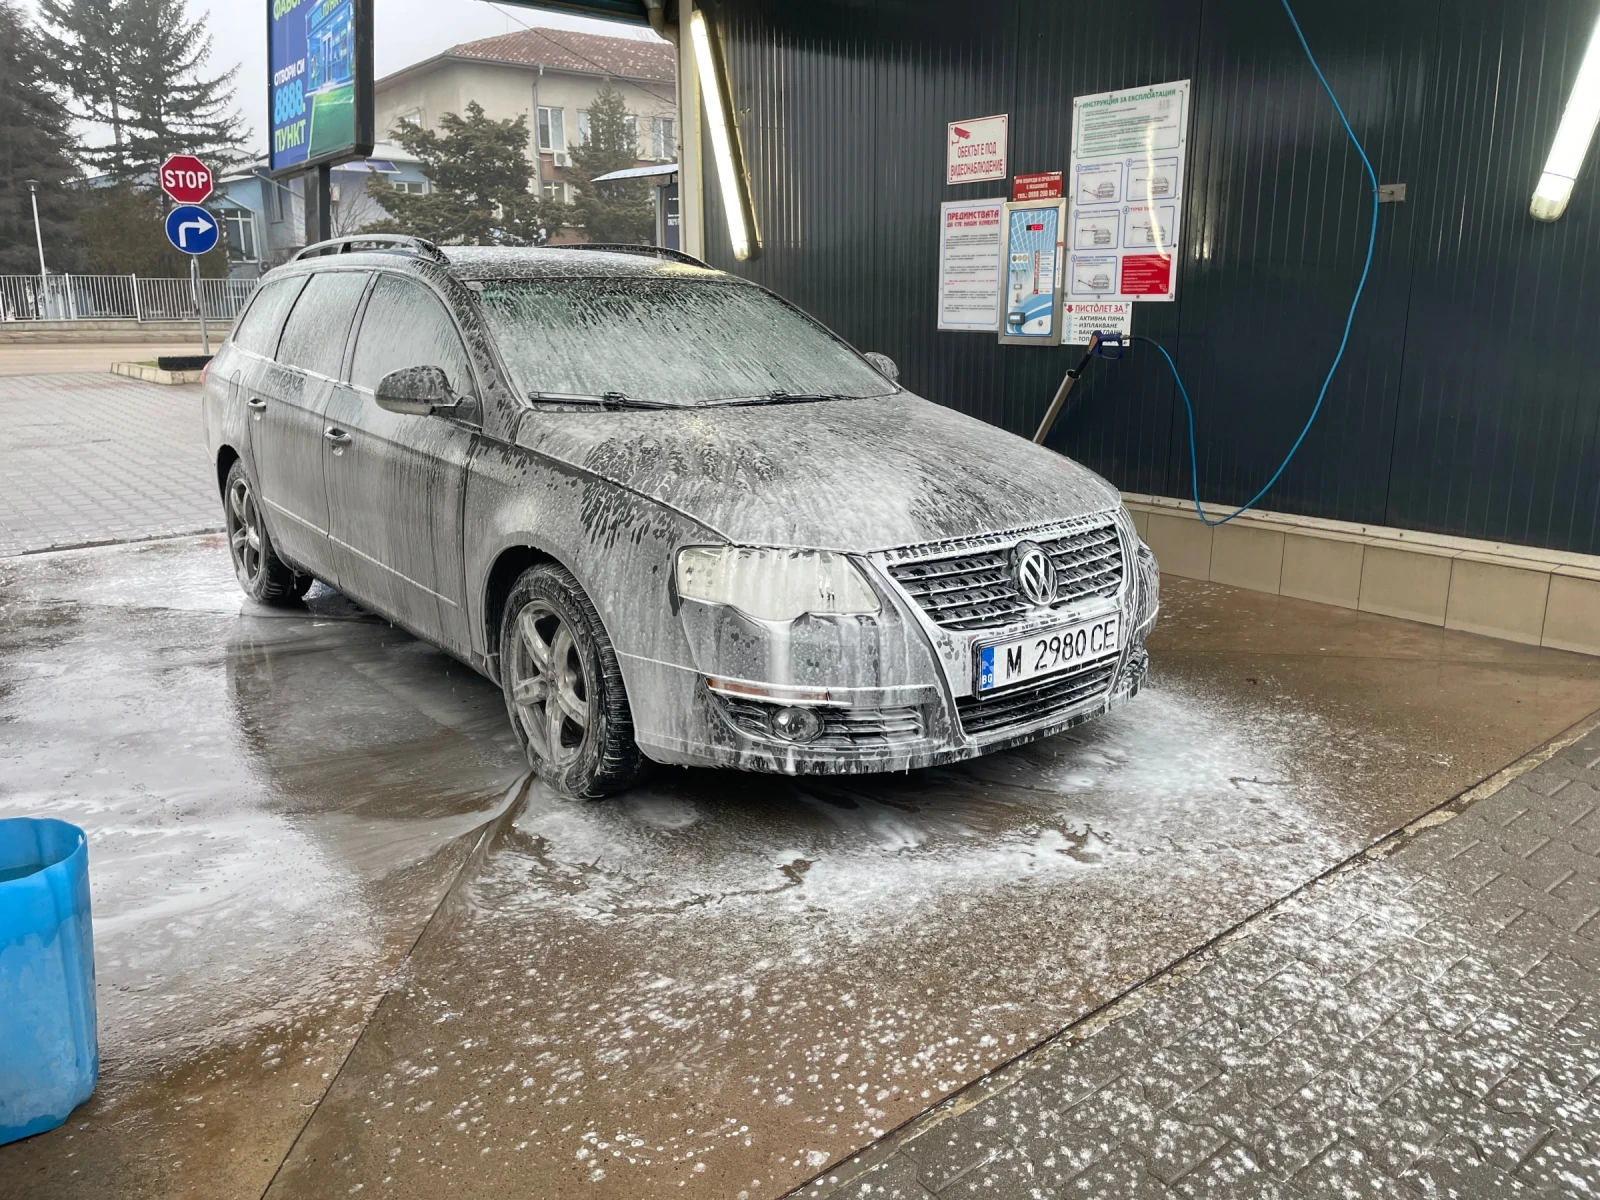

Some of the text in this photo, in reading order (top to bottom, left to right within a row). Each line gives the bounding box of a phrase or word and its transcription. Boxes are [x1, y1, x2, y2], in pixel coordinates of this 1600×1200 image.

[274, 58, 305, 86] ОТВОРИ СИ
[1082, 98, 1119, 108] ИНСТРУКЦИЯ
[1128, 89, 1176, 102] ЕКСПЛОАТАЦИЯ
[274, 119, 306, 153] ПУНКТ
[958, 142, 997, 158] ОБЕКТЪТ Е ПОД
[951, 159, 1003, 178] ВИДЕОНАБЛЮДЕНИЕ
[164, 169, 208, 189] STOP
[947, 210, 999, 221] ПРЕДИМСТВАТА
[1075, 304, 1112, 312] ПИСТОЛЕТ
[1006, 645, 1022, 679] M
[982, 673, 993, 684] BG
